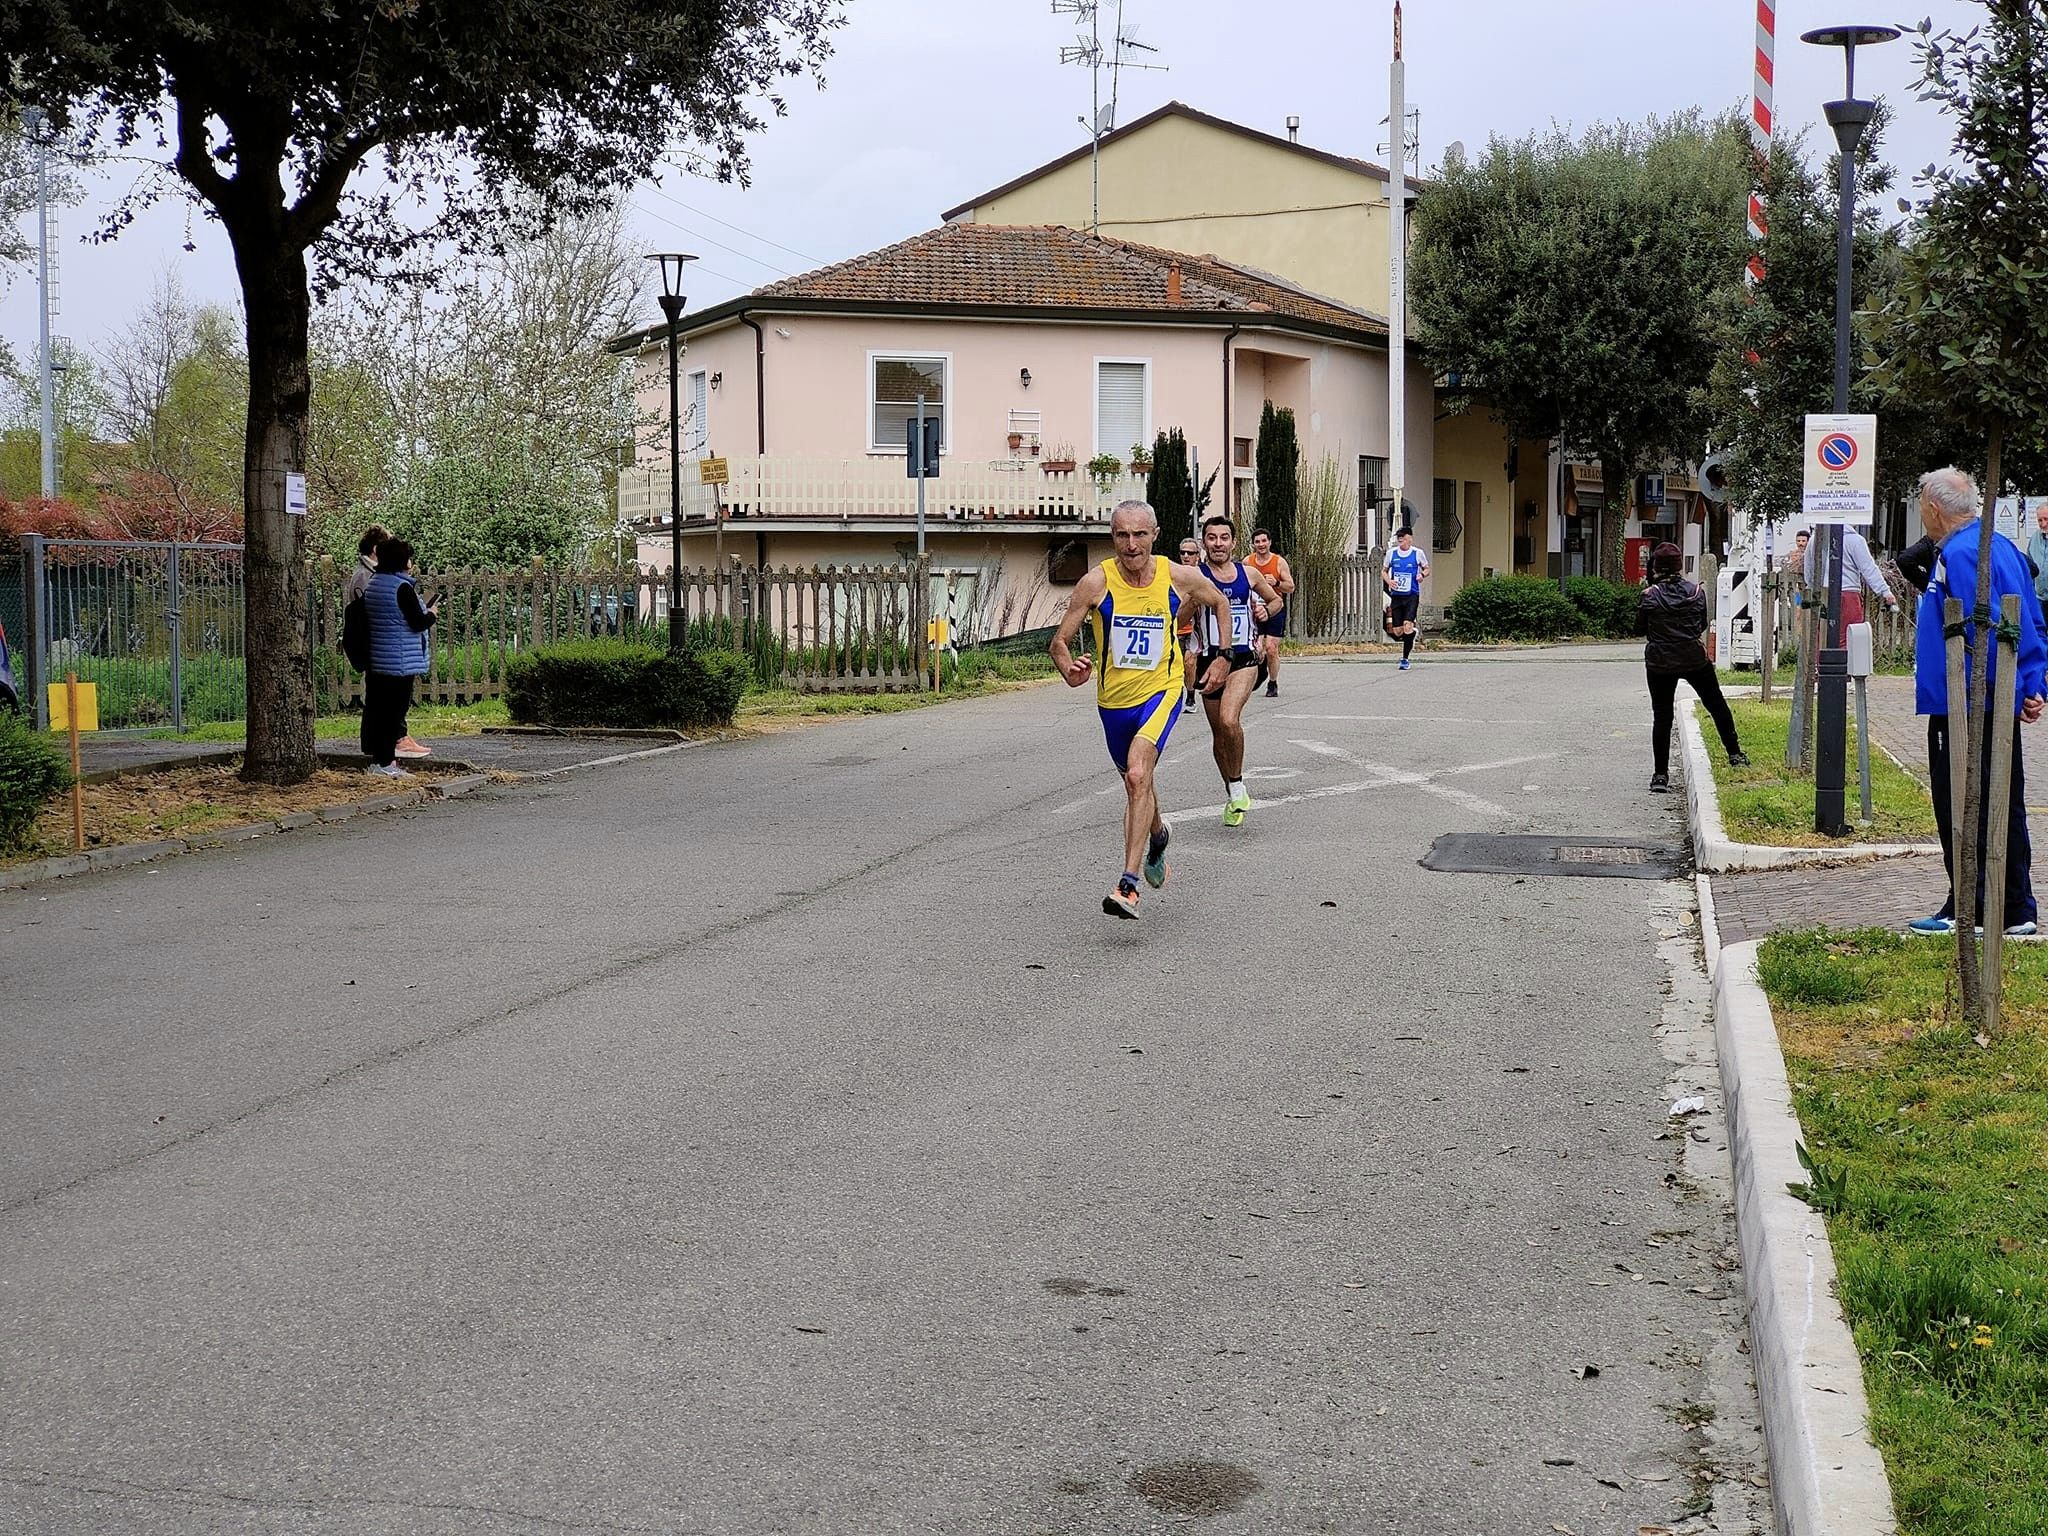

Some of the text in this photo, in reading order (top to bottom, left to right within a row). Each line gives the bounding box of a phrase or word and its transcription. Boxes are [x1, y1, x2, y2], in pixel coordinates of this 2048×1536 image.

[1580, 468, 1601, 480] TABAC
[1647, 474, 1663, 497] T
[1234, 616, 1242, 635] 2
[1127, 629, 1150, 656] 25
